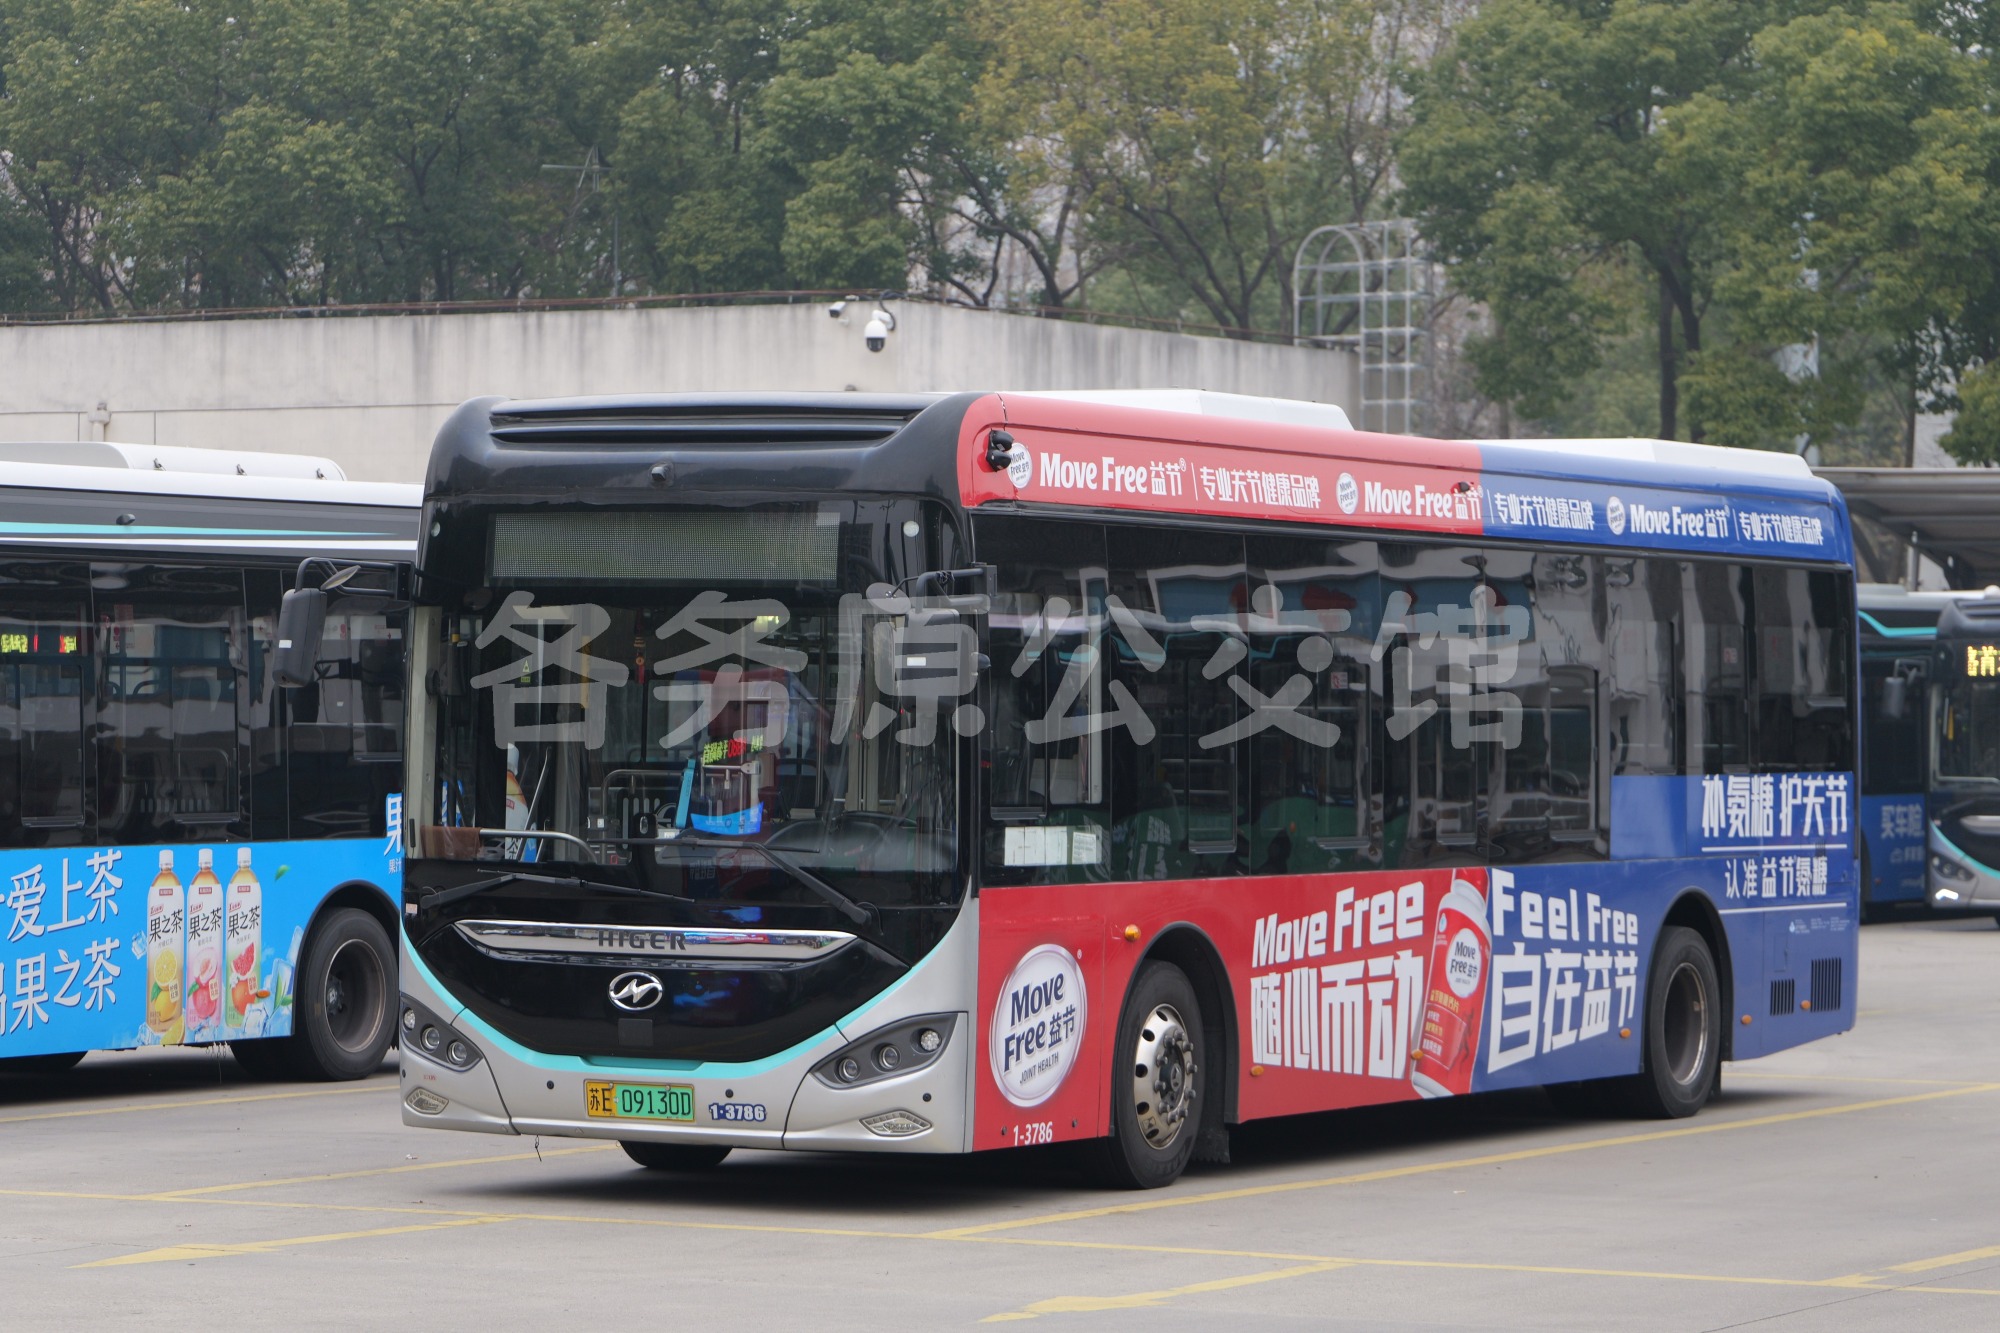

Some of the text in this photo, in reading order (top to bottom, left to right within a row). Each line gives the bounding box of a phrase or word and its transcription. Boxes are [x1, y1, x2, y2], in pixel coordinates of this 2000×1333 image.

[1040, 452, 1097, 490] Move
[1200, 466, 1321, 509] 专业关节健康品牌
[1364, 481, 1412, 515] Move
[1494, 492, 1595, 531] 专业关节健康品牌
[1629, 503, 1671, 535] Move
[1738, 510, 1824, 546] 专业关节健康品牌
[0, 848, 123, 942] 爱上茶
[1491, 868, 1639, 946] Feel Free
[149, 908, 183, 945] 果之茶
[188, 906, 222, 942] 果之茶
[227, 905, 260, 940] 果之茶
[598, 929, 686, 951] HIGER
[1251, 881, 1425, 968] Move Free
[1450, 958, 1468, 975] Free
[1454, 941, 1476, 960] Move
[0, 937, 121, 1035] 果之茶
[1010, 972, 1065, 1028] Move
[1487, 941, 1639, 1074] 自在益节
[1004, 1003, 1076, 1073] Free 益节
[1250, 949, 1425, 1080] 随心而动
[1019, 1052, 1059, 1085] JOINT HEALTH
[1013, 1121, 1053, 1147] 1-3786
